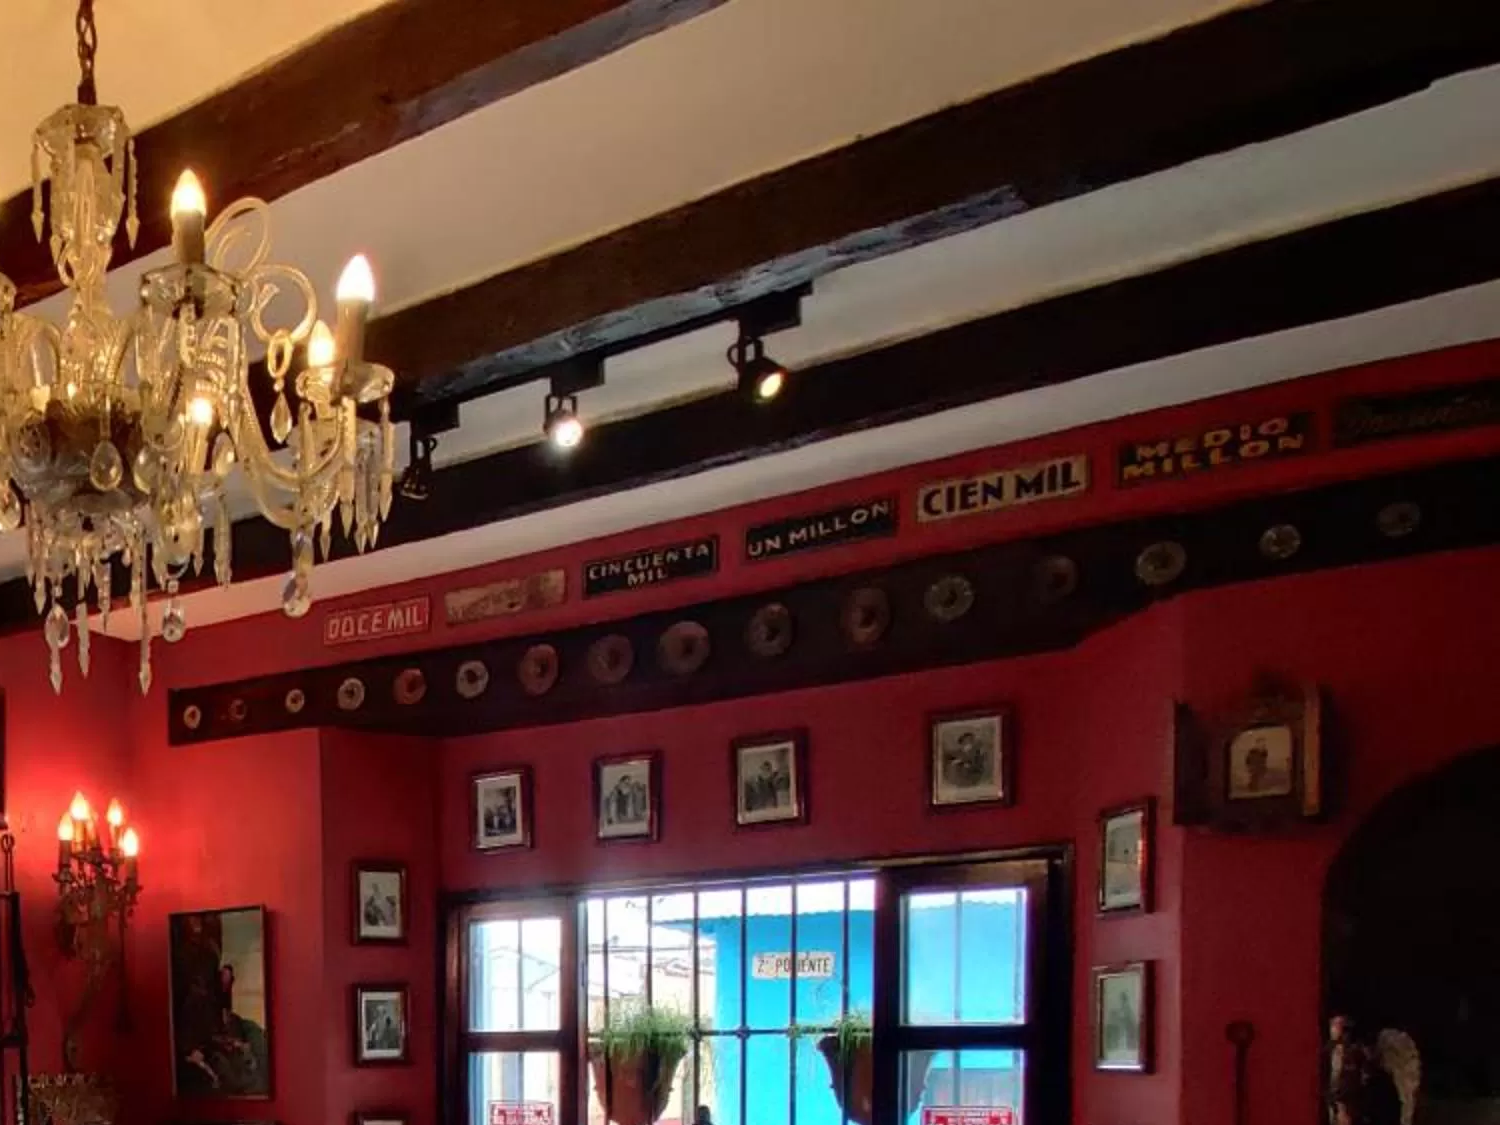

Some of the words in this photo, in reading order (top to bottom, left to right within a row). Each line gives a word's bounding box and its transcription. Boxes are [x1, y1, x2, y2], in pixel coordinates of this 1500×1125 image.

[921, 475, 1004, 518] CIEN
[1014, 462, 1082, 500] MIL
[747, 535, 782, 557] UN
[788, 501, 889, 546] MILLON
[588, 543, 710, 582] CINCUENTA
[627, 569, 669, 588] MIL
[326, 611, 384, 640] DOCE
[386, 604, 423, 635] MIL
[775, 956, 830, 974] POIENTE
